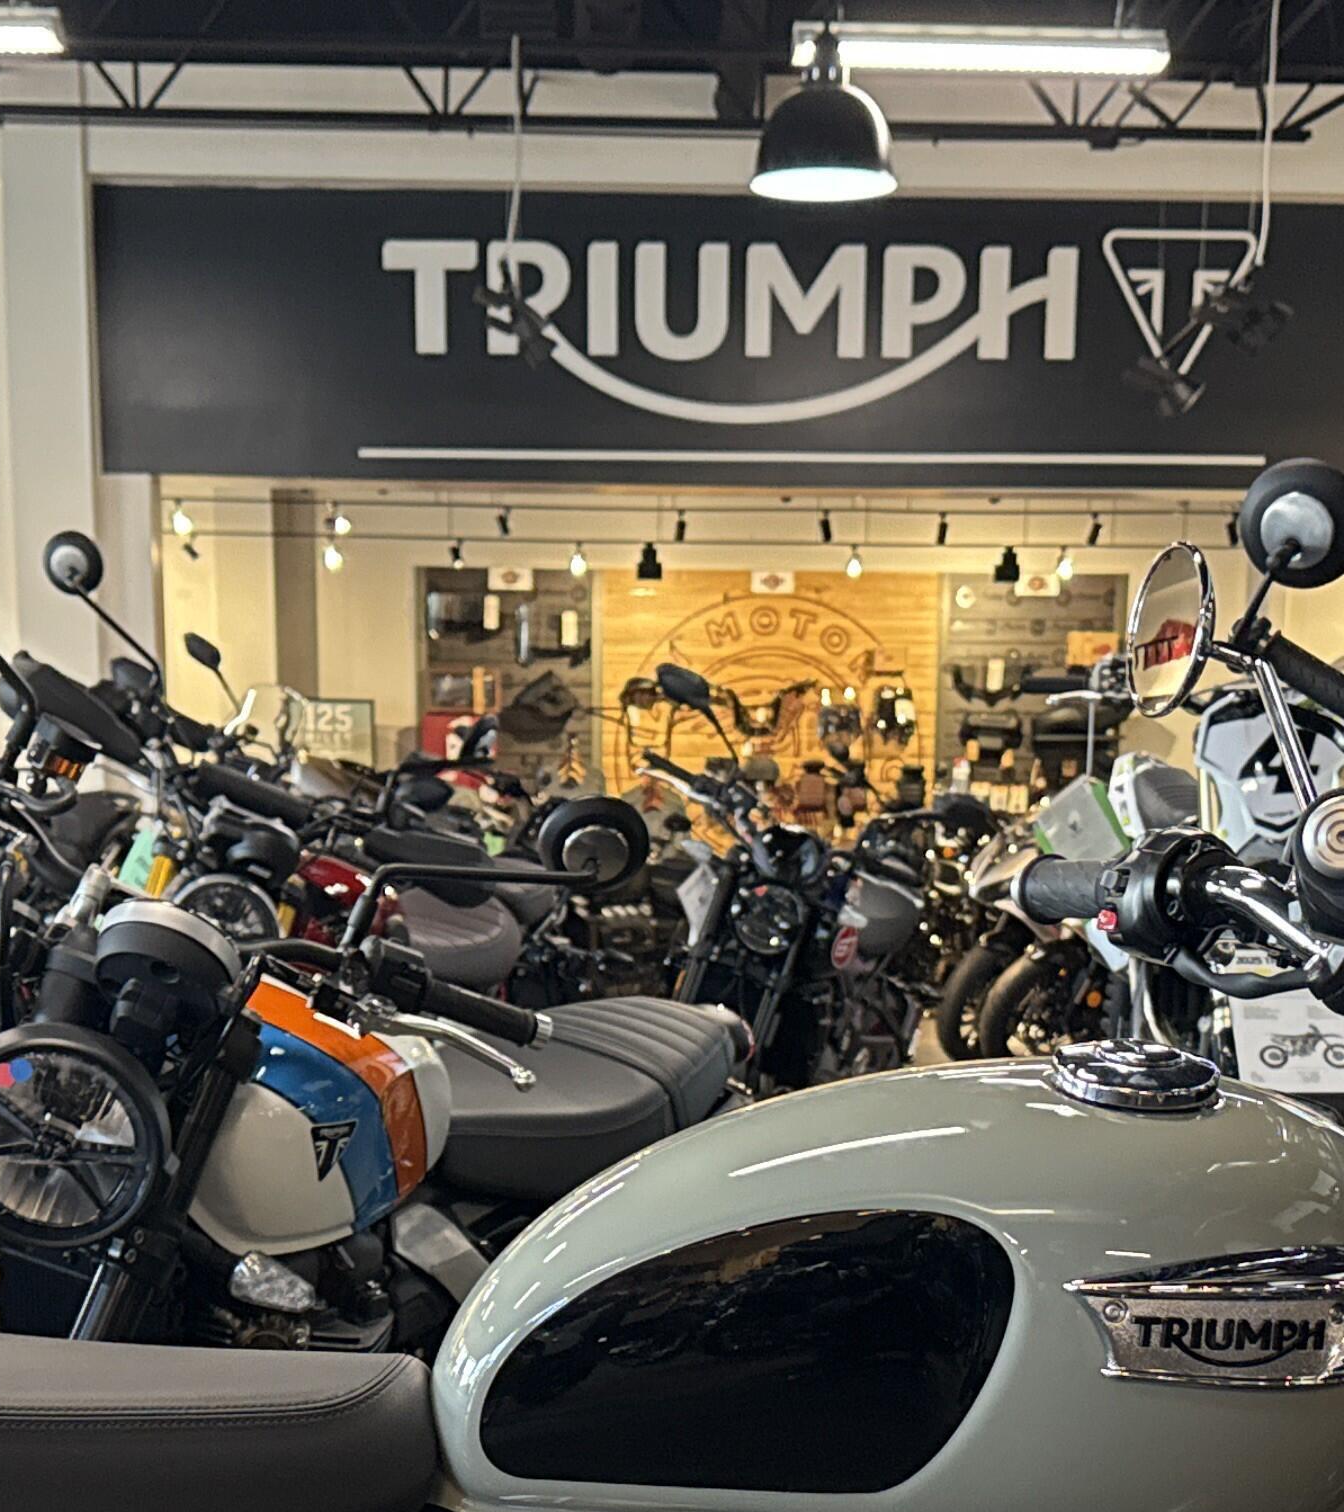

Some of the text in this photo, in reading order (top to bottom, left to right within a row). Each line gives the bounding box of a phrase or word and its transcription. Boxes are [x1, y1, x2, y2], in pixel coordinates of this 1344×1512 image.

[381, 239, 1081, 424] TRIUMPH
[304, 703, 354, 733] 125
[1131, 1315, 1327, 1368] TRIUMPH
